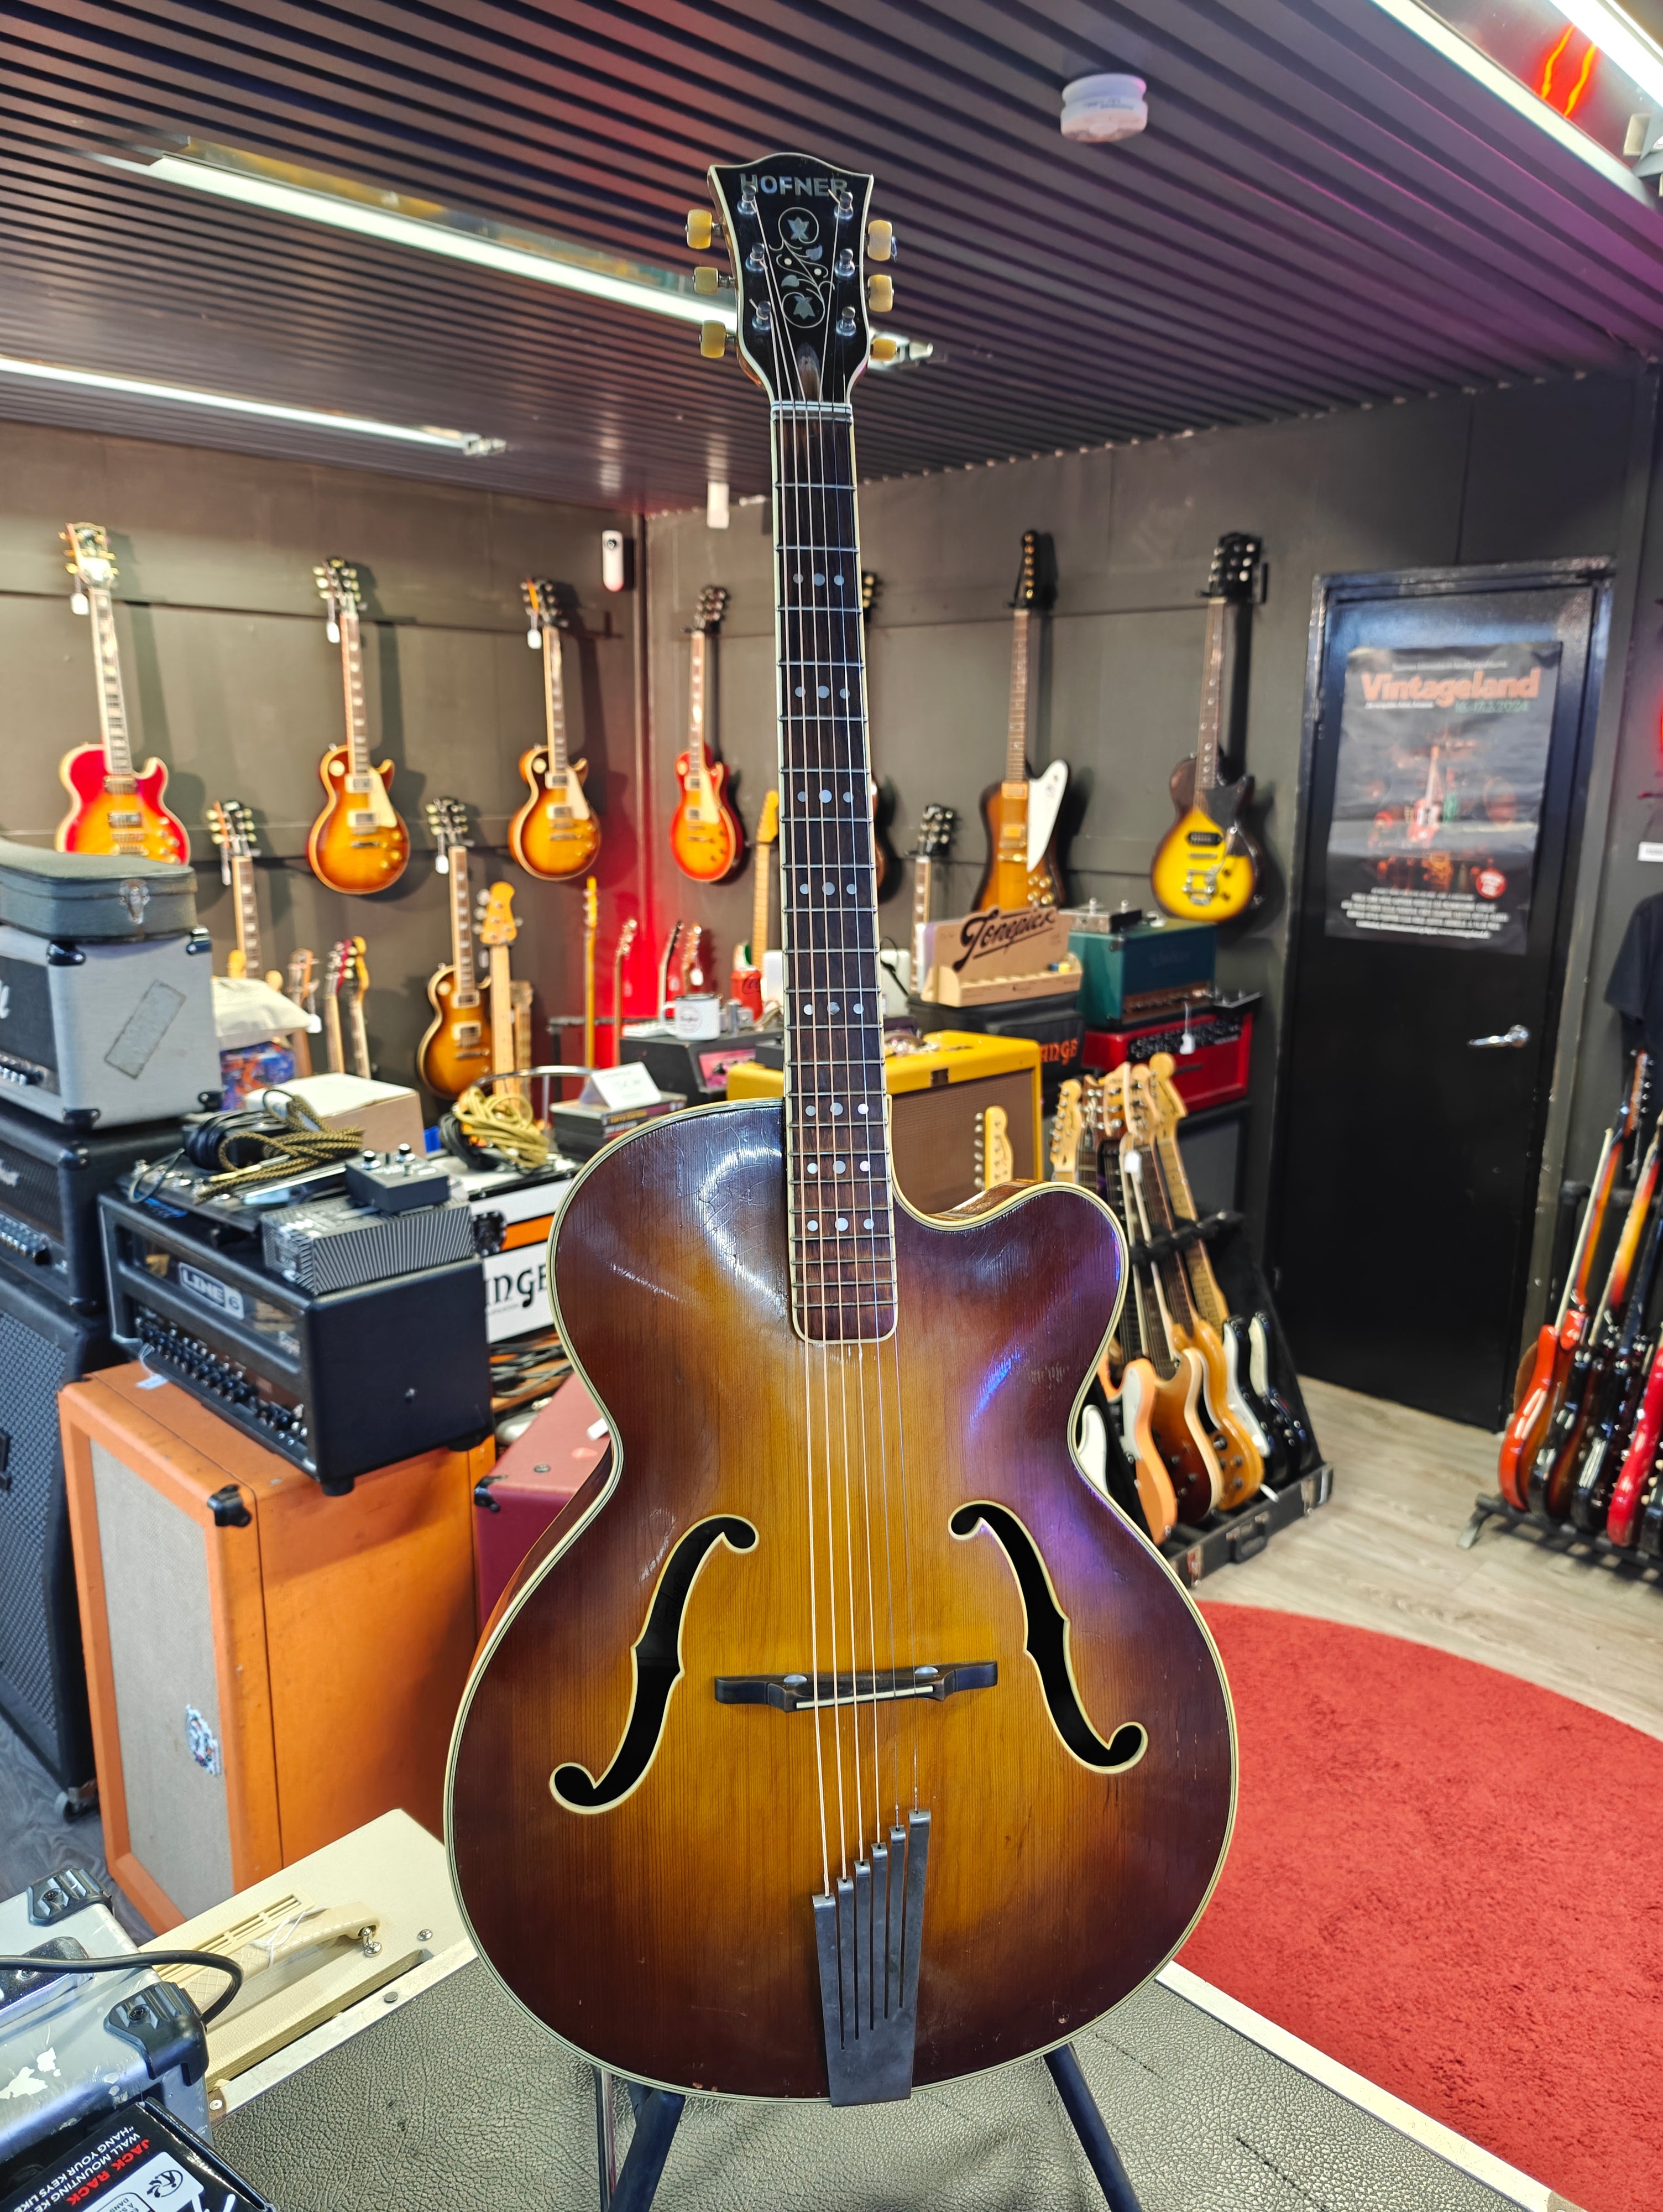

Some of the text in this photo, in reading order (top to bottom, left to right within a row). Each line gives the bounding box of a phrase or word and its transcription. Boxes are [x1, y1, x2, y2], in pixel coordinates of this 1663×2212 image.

[740, 173, 848, 196] HOFNER
[1361, 667, 1541, 708] Vintageland
[182, 1269, 240, 1309] LINE 6
[30, 2132, 140, 2212] WALL MOUNTING KE
[66, 2151, 100, 2177] YOUR
[66, 2138, 150, 2206] JACK RACK
[39, 2173, 67, 2198] KEYS
